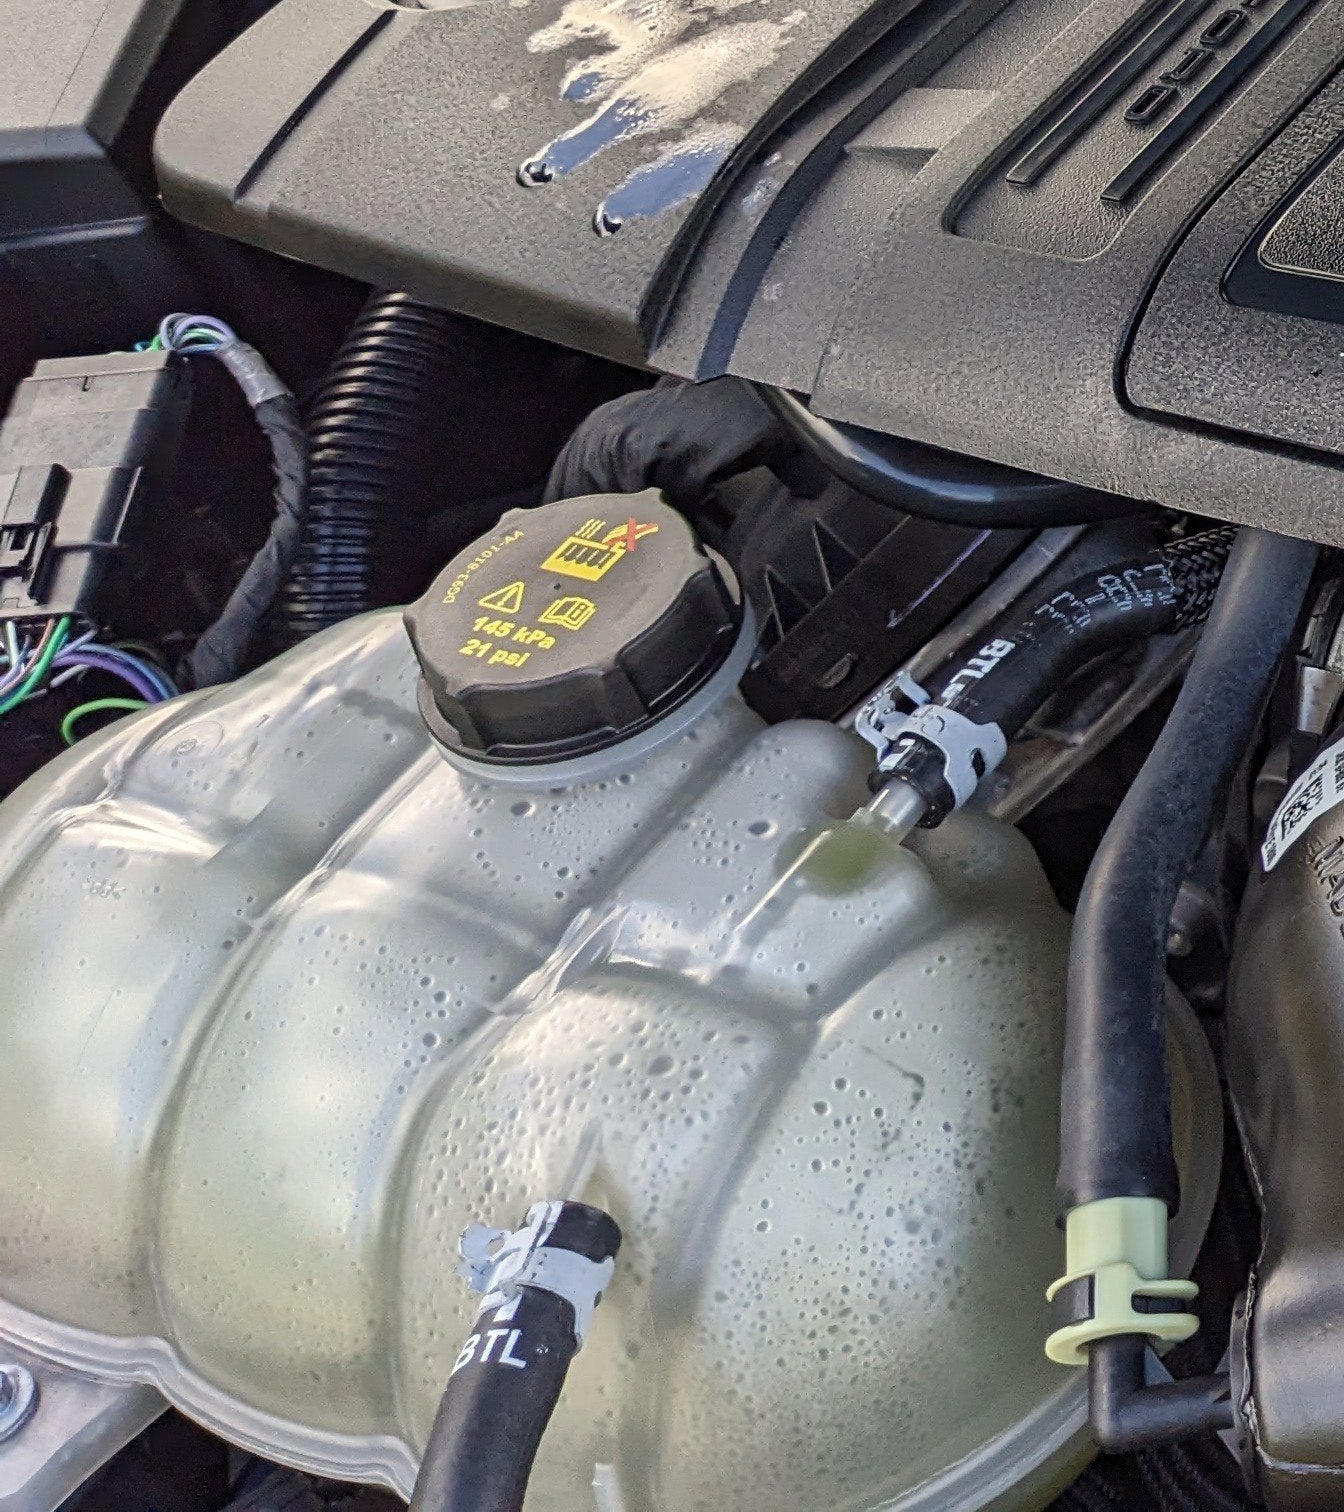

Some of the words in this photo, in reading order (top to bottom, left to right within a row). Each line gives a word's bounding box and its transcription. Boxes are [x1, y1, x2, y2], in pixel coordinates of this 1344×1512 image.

[472, 616, 511, 639] 145
[512, 627, 556, 650] kPa
[459, 639, 485, 659] 21
